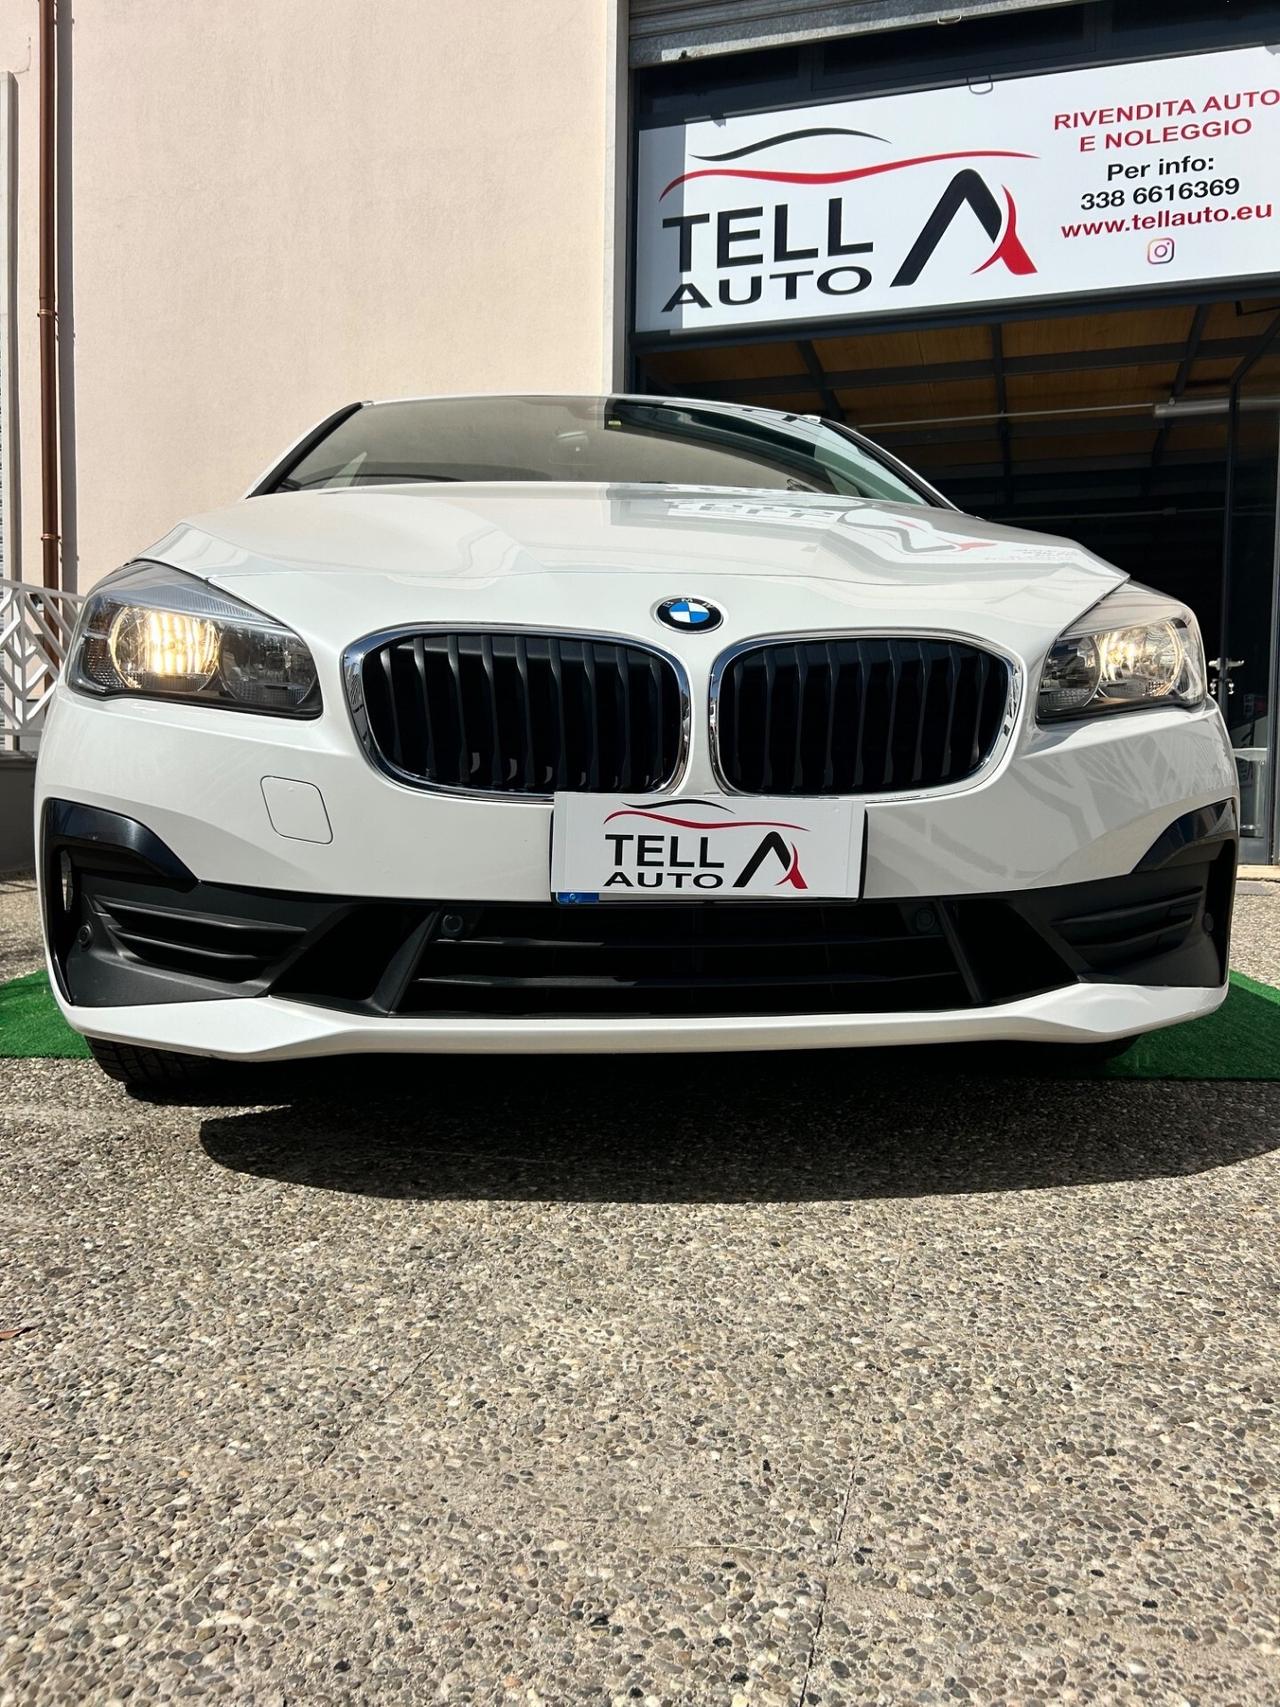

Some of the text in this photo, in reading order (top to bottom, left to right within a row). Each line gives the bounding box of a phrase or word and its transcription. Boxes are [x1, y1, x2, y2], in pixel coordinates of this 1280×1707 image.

[1054, 89, 1280, 130] RIVENDITA AUTO
[1080, 118, 1252, 152] E NOLEGGIO
[1107, 156, 1214, 181] Per info:
[1080, 177, 1240, 211] 338 6616369
[662, 197, 874, 273] TELL
[1060, 203, 1273, 238] www.tellauto.eu
[661, 265, 873, 312] AUTO
[604, 834, 725, 868] TELL
[603, 871, 724, 889] AUTO
